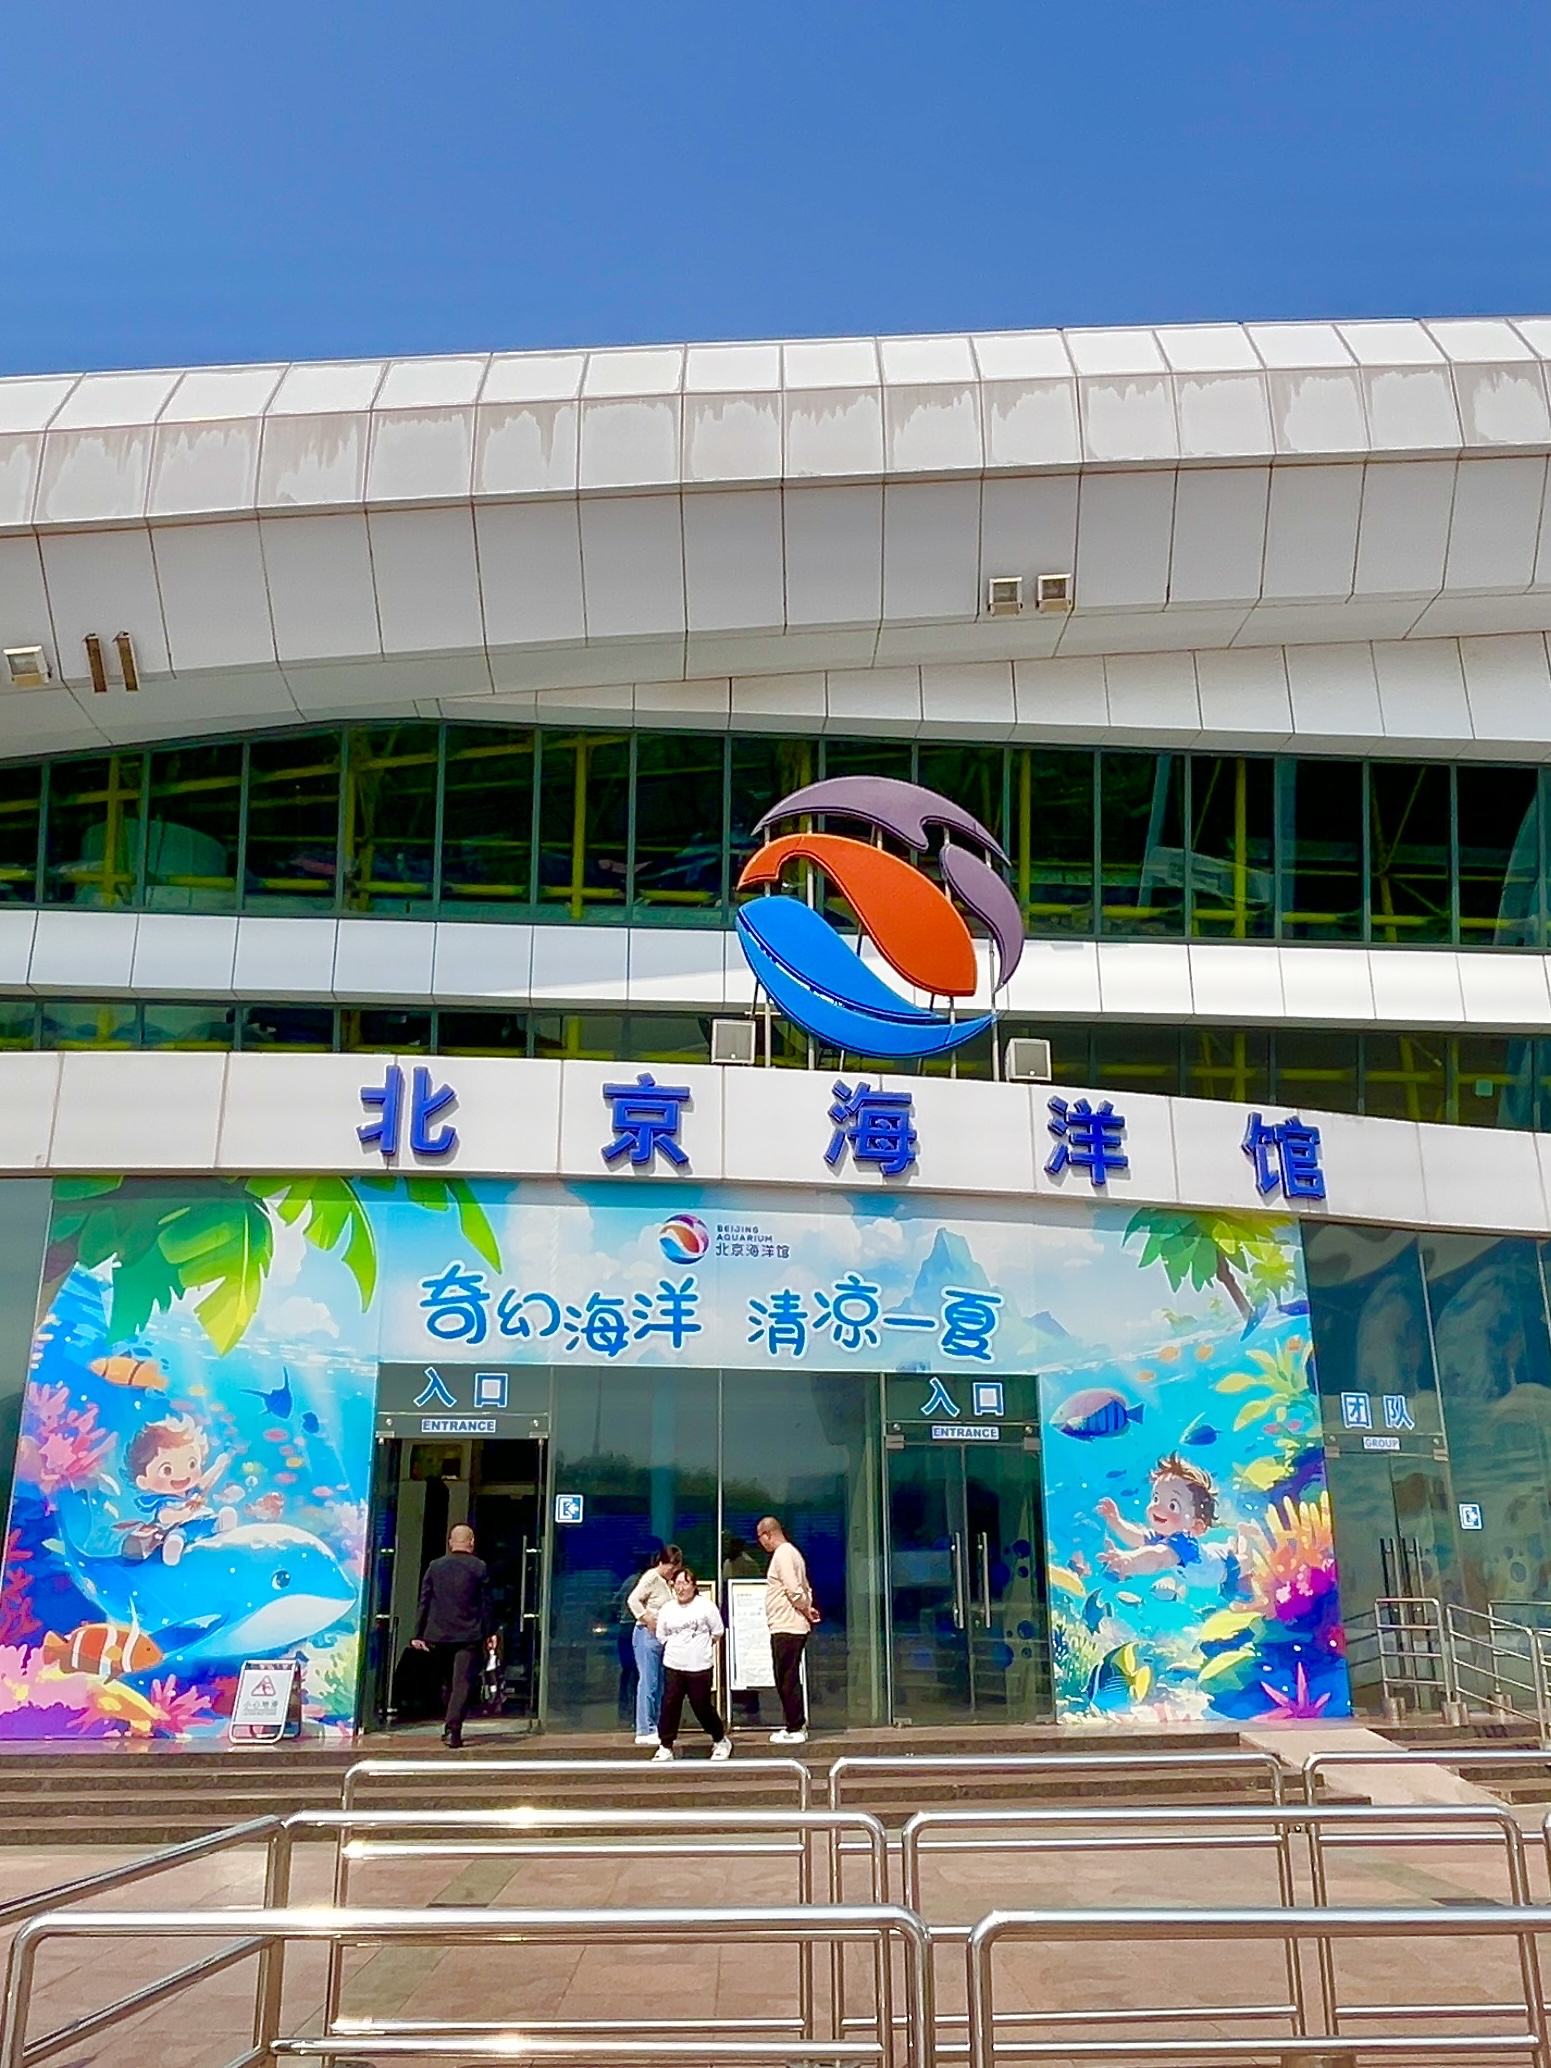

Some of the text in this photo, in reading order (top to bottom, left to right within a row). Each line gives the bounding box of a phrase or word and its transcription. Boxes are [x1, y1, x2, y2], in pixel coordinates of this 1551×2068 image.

[358, 1064, 1326, 1199] 北京海洋馆
[717, 1224, 758, 1233] BEIJING
[716, 1234, 773, 1243] AQUARIUM
[715, 1243, 790, 1258] 北京海洋馆
[419, 1264, 1002, 1361] 奇幻海洋 清凉一夏
[413, 1366, 508, 1408] 入口
[921, 1377, 1004, 1417] 入口
[1341, 1392, 1415, 1430] 团队
[422, 1420, 495, 1432] ENTRANCE
[932, 1427, 998, 1438] ENTRANCE
[1364, 1438, 1399, 1448] GROUP
